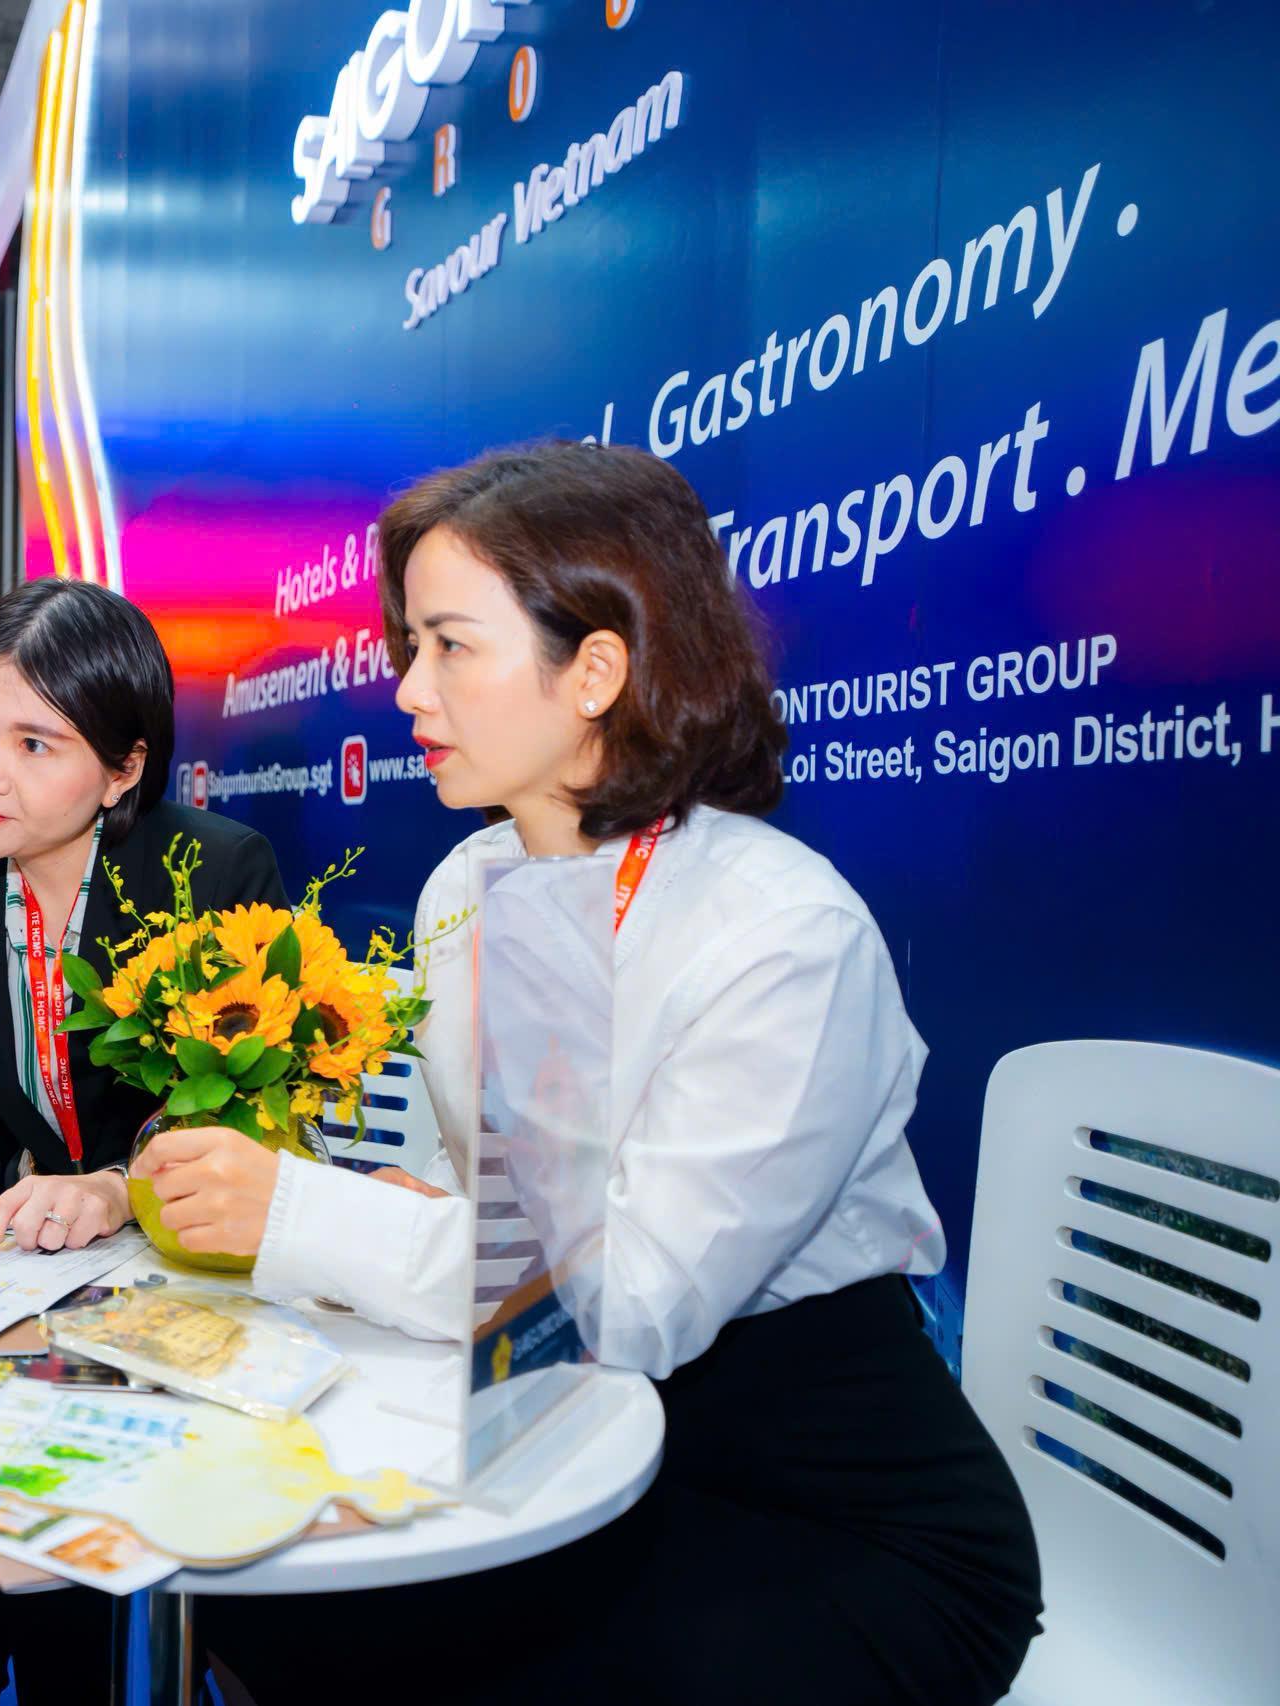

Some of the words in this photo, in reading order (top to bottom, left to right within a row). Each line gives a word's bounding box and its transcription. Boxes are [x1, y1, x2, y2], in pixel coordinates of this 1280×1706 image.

[403, 212, 508, 331] Savour
[513, 70, 683, 243] Vietnam
[648, 162, 1100, 459] Gastronomy
[275, 543, 337, 618] Hotels
[341, 533, 360, 590] &
[222, 647, 330, 719] Amusement
[331, 636, 350, 691] &
[967, 634, 1117, 702] GROUP
[824, 736, 922, 783] Street,
[933, 726, 1060, 783] Saigon
[1073, 700, 1242, 767] District,
[31, 911, 39, 926] ITE
[31, 927, 42, 958] HCMC
[35, 981, 45, 997] ITE
[36, 1000, 46, 1033] HCMC
[60, 1057, 69, 1090] HCMC
[64, 1093, 73, 1109] ITE
